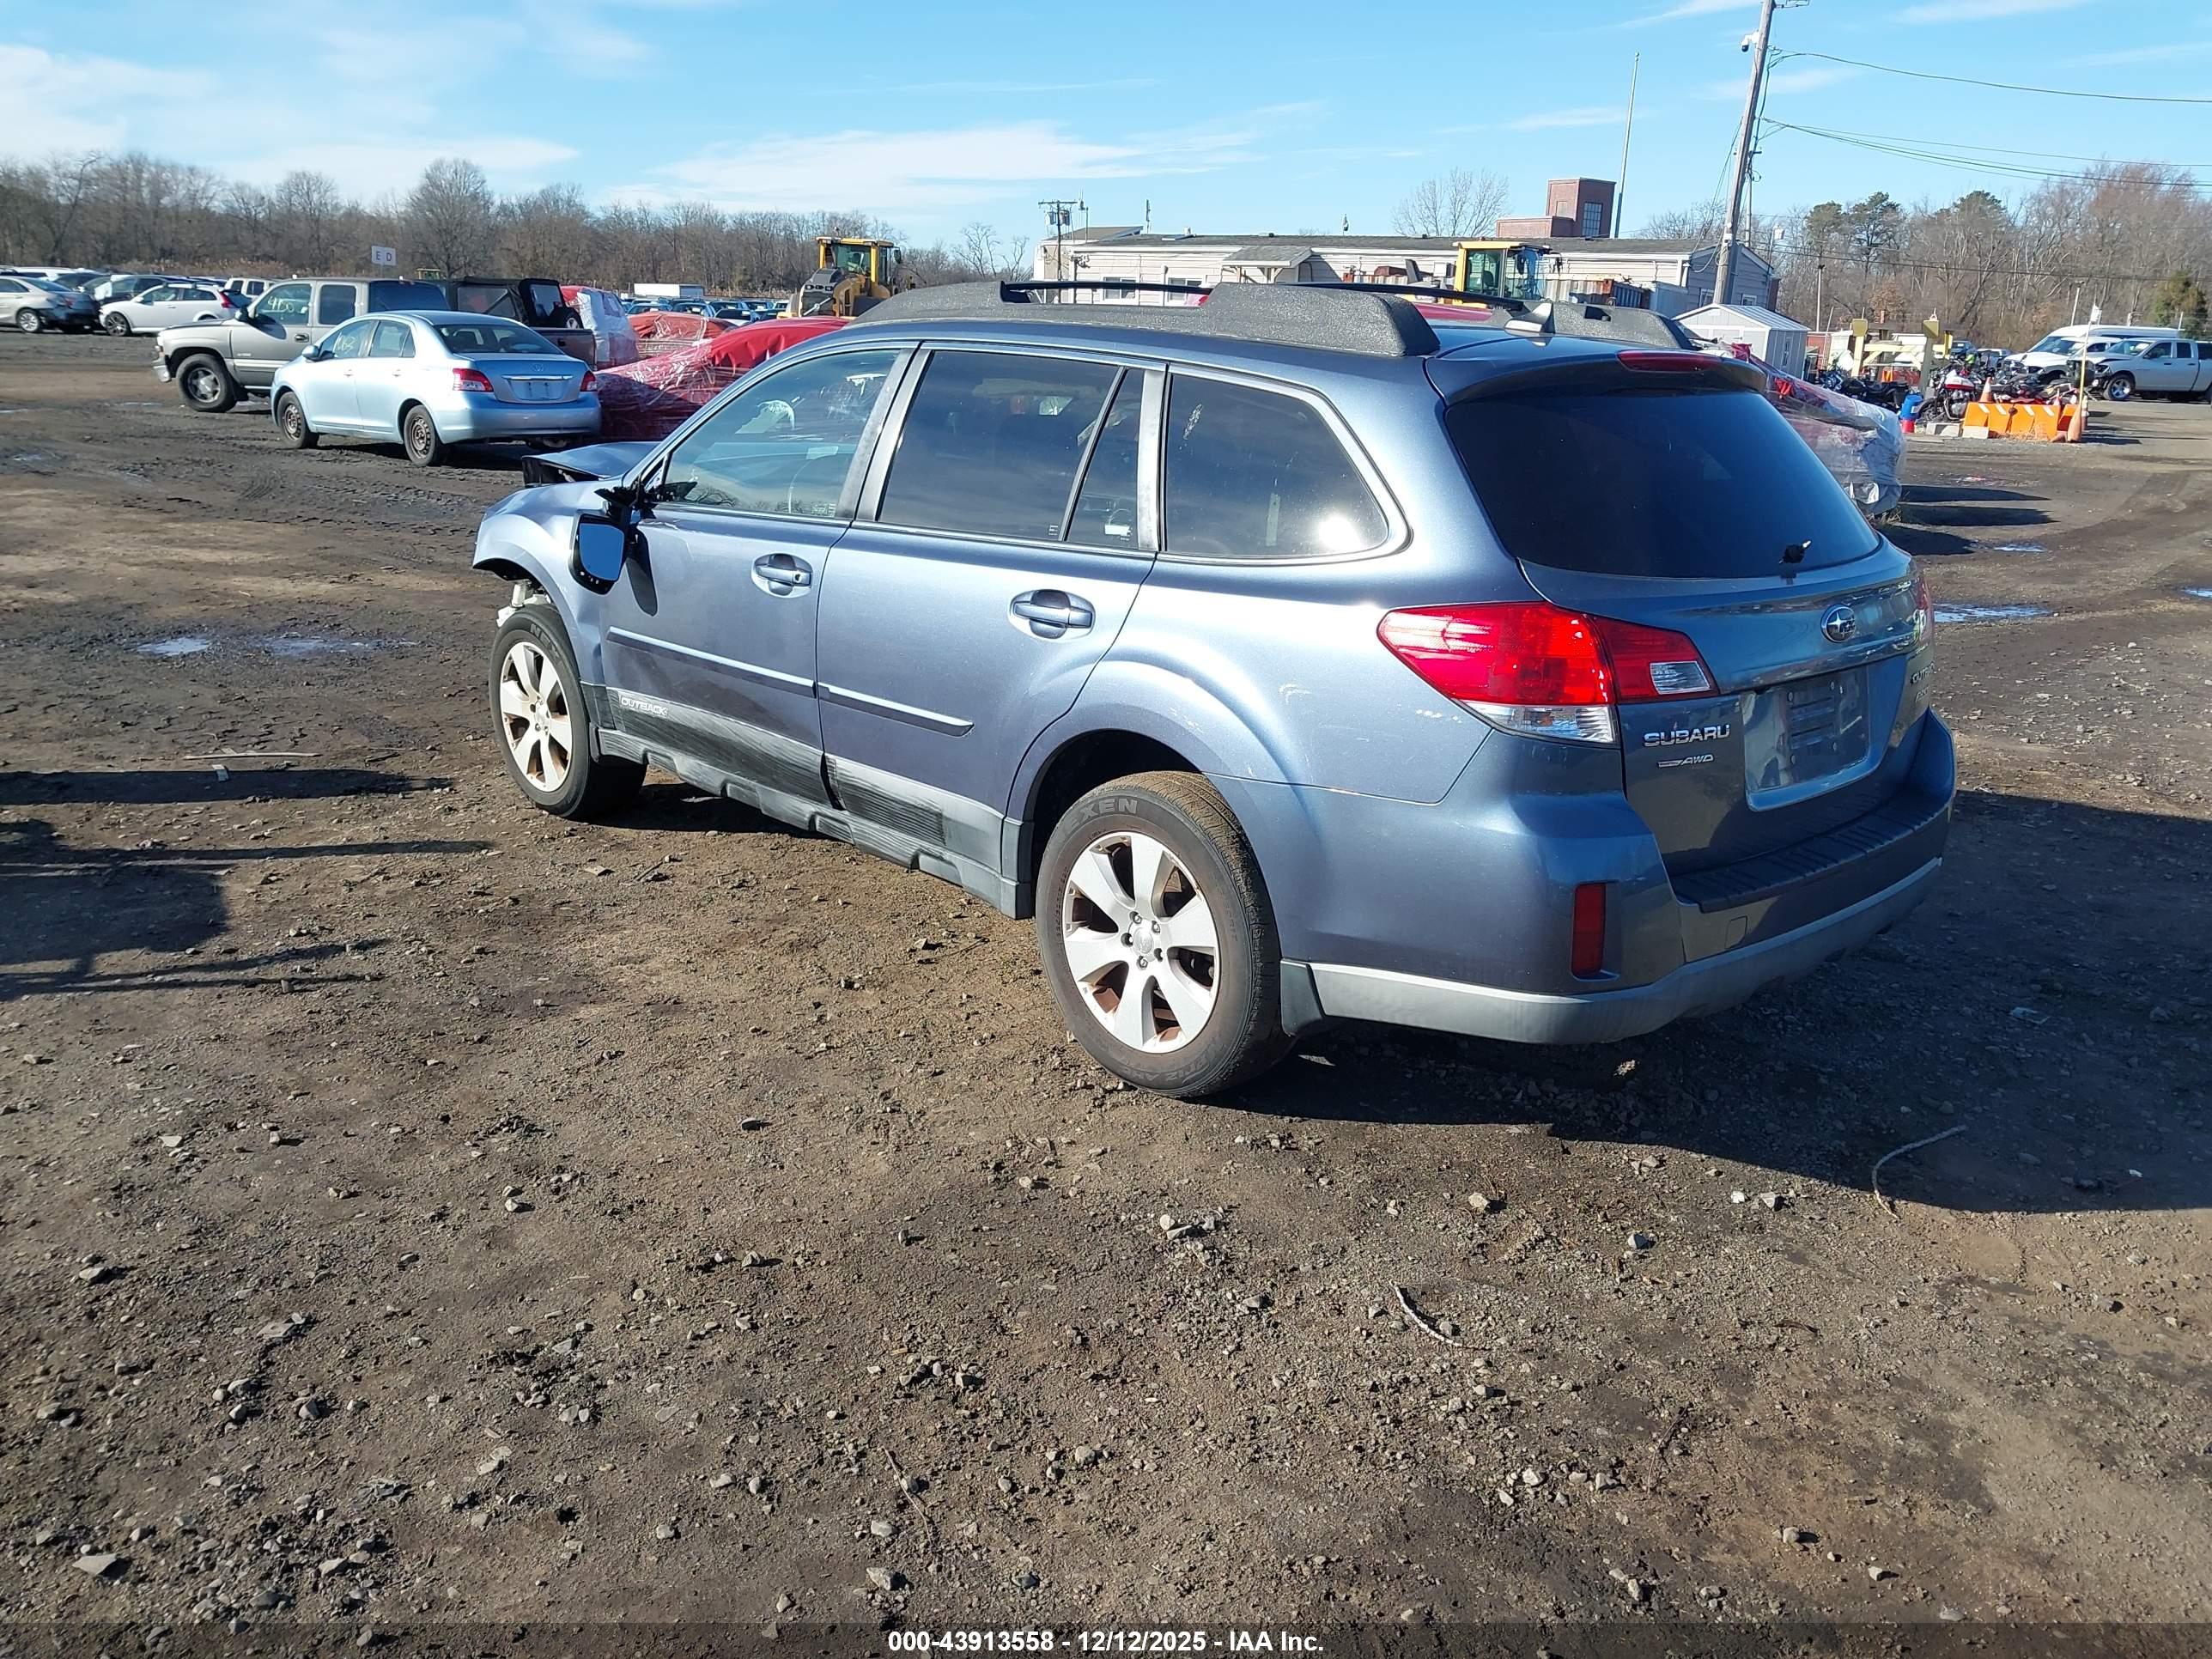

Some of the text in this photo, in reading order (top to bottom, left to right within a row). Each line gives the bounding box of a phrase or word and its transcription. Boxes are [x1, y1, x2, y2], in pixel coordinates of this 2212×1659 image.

[376, 251, 392, 262] E D
[621, 696, 668, 716] OUTBACK
[1644, 724, 1730, 747] SUBARU
